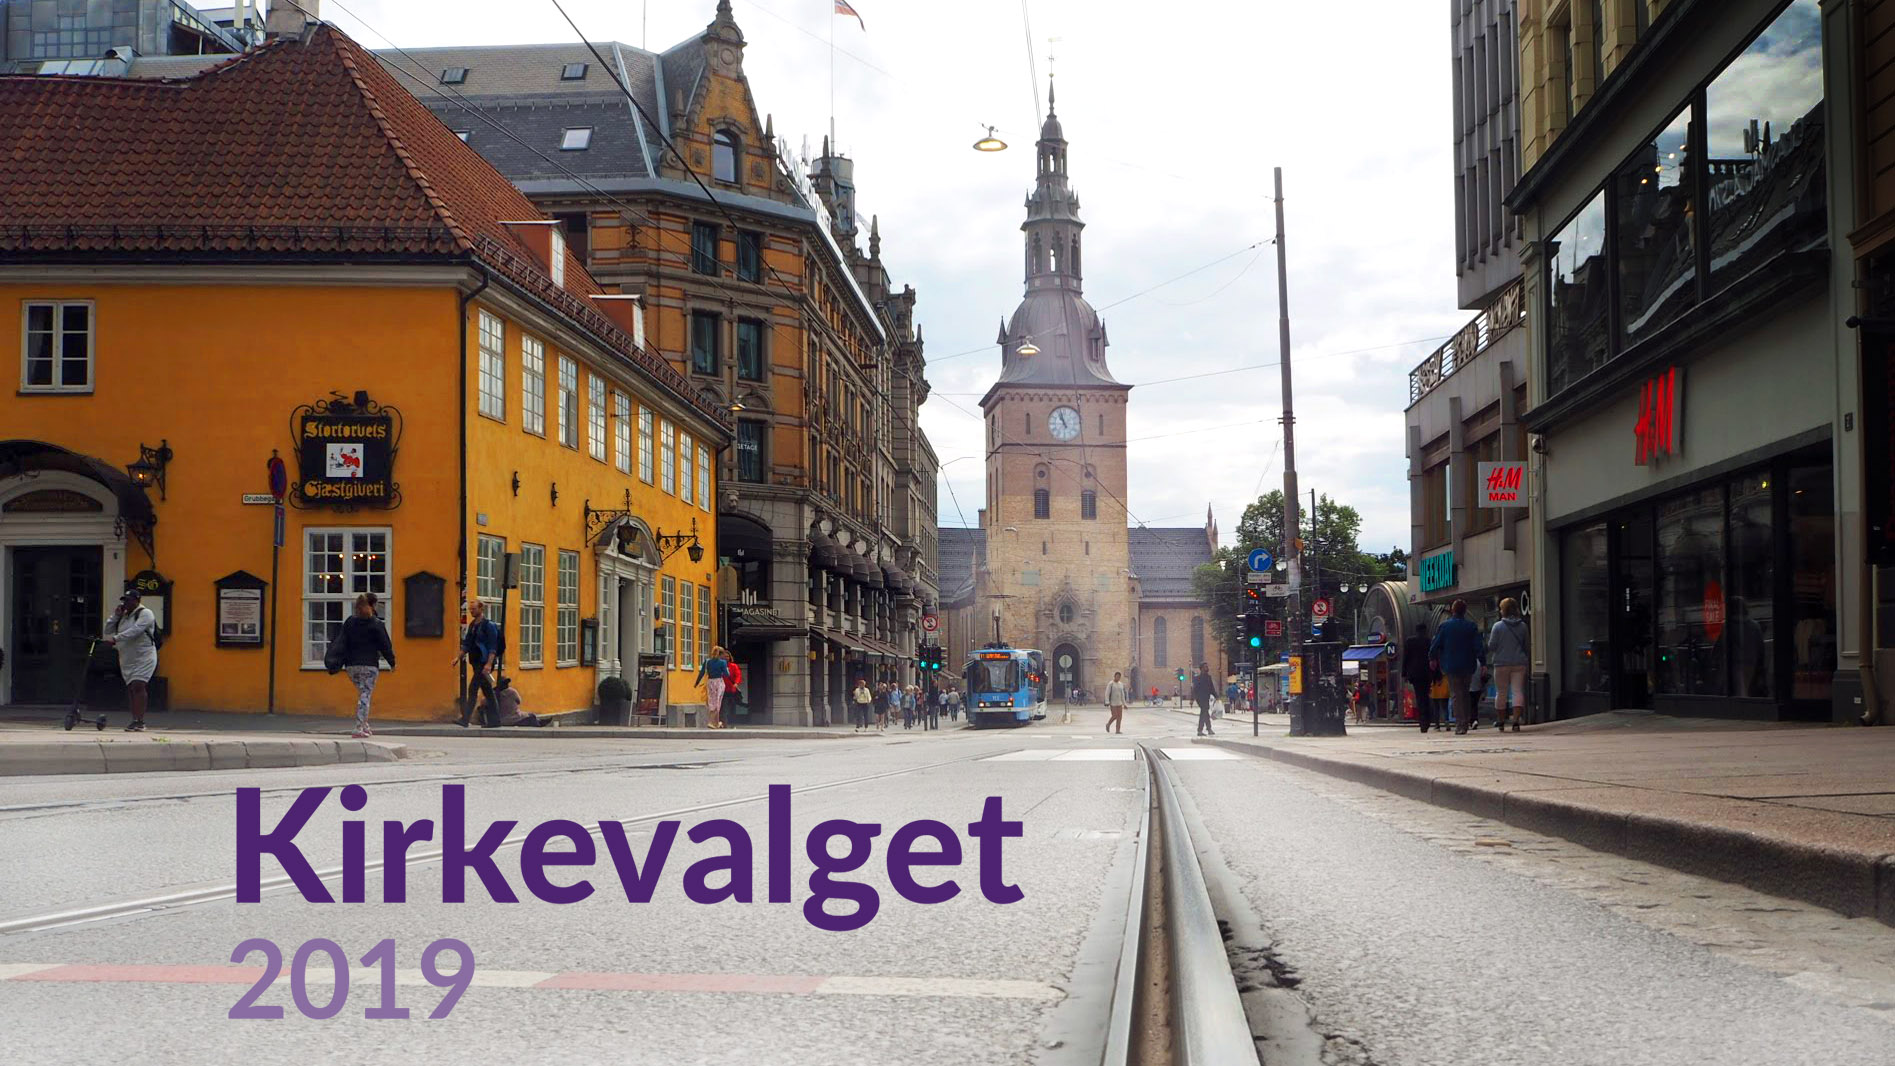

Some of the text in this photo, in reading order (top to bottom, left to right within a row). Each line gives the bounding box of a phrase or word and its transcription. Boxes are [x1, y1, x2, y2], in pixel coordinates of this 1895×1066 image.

[304, 421, 387, 439] Stortorvets
[1487, 466, 1523, 490] H&M
[1489, 492, 1517, 501] MAN
[1420, 551, 1454, 592] WEEKDAY
[1387, 645, 1395, 654] N
